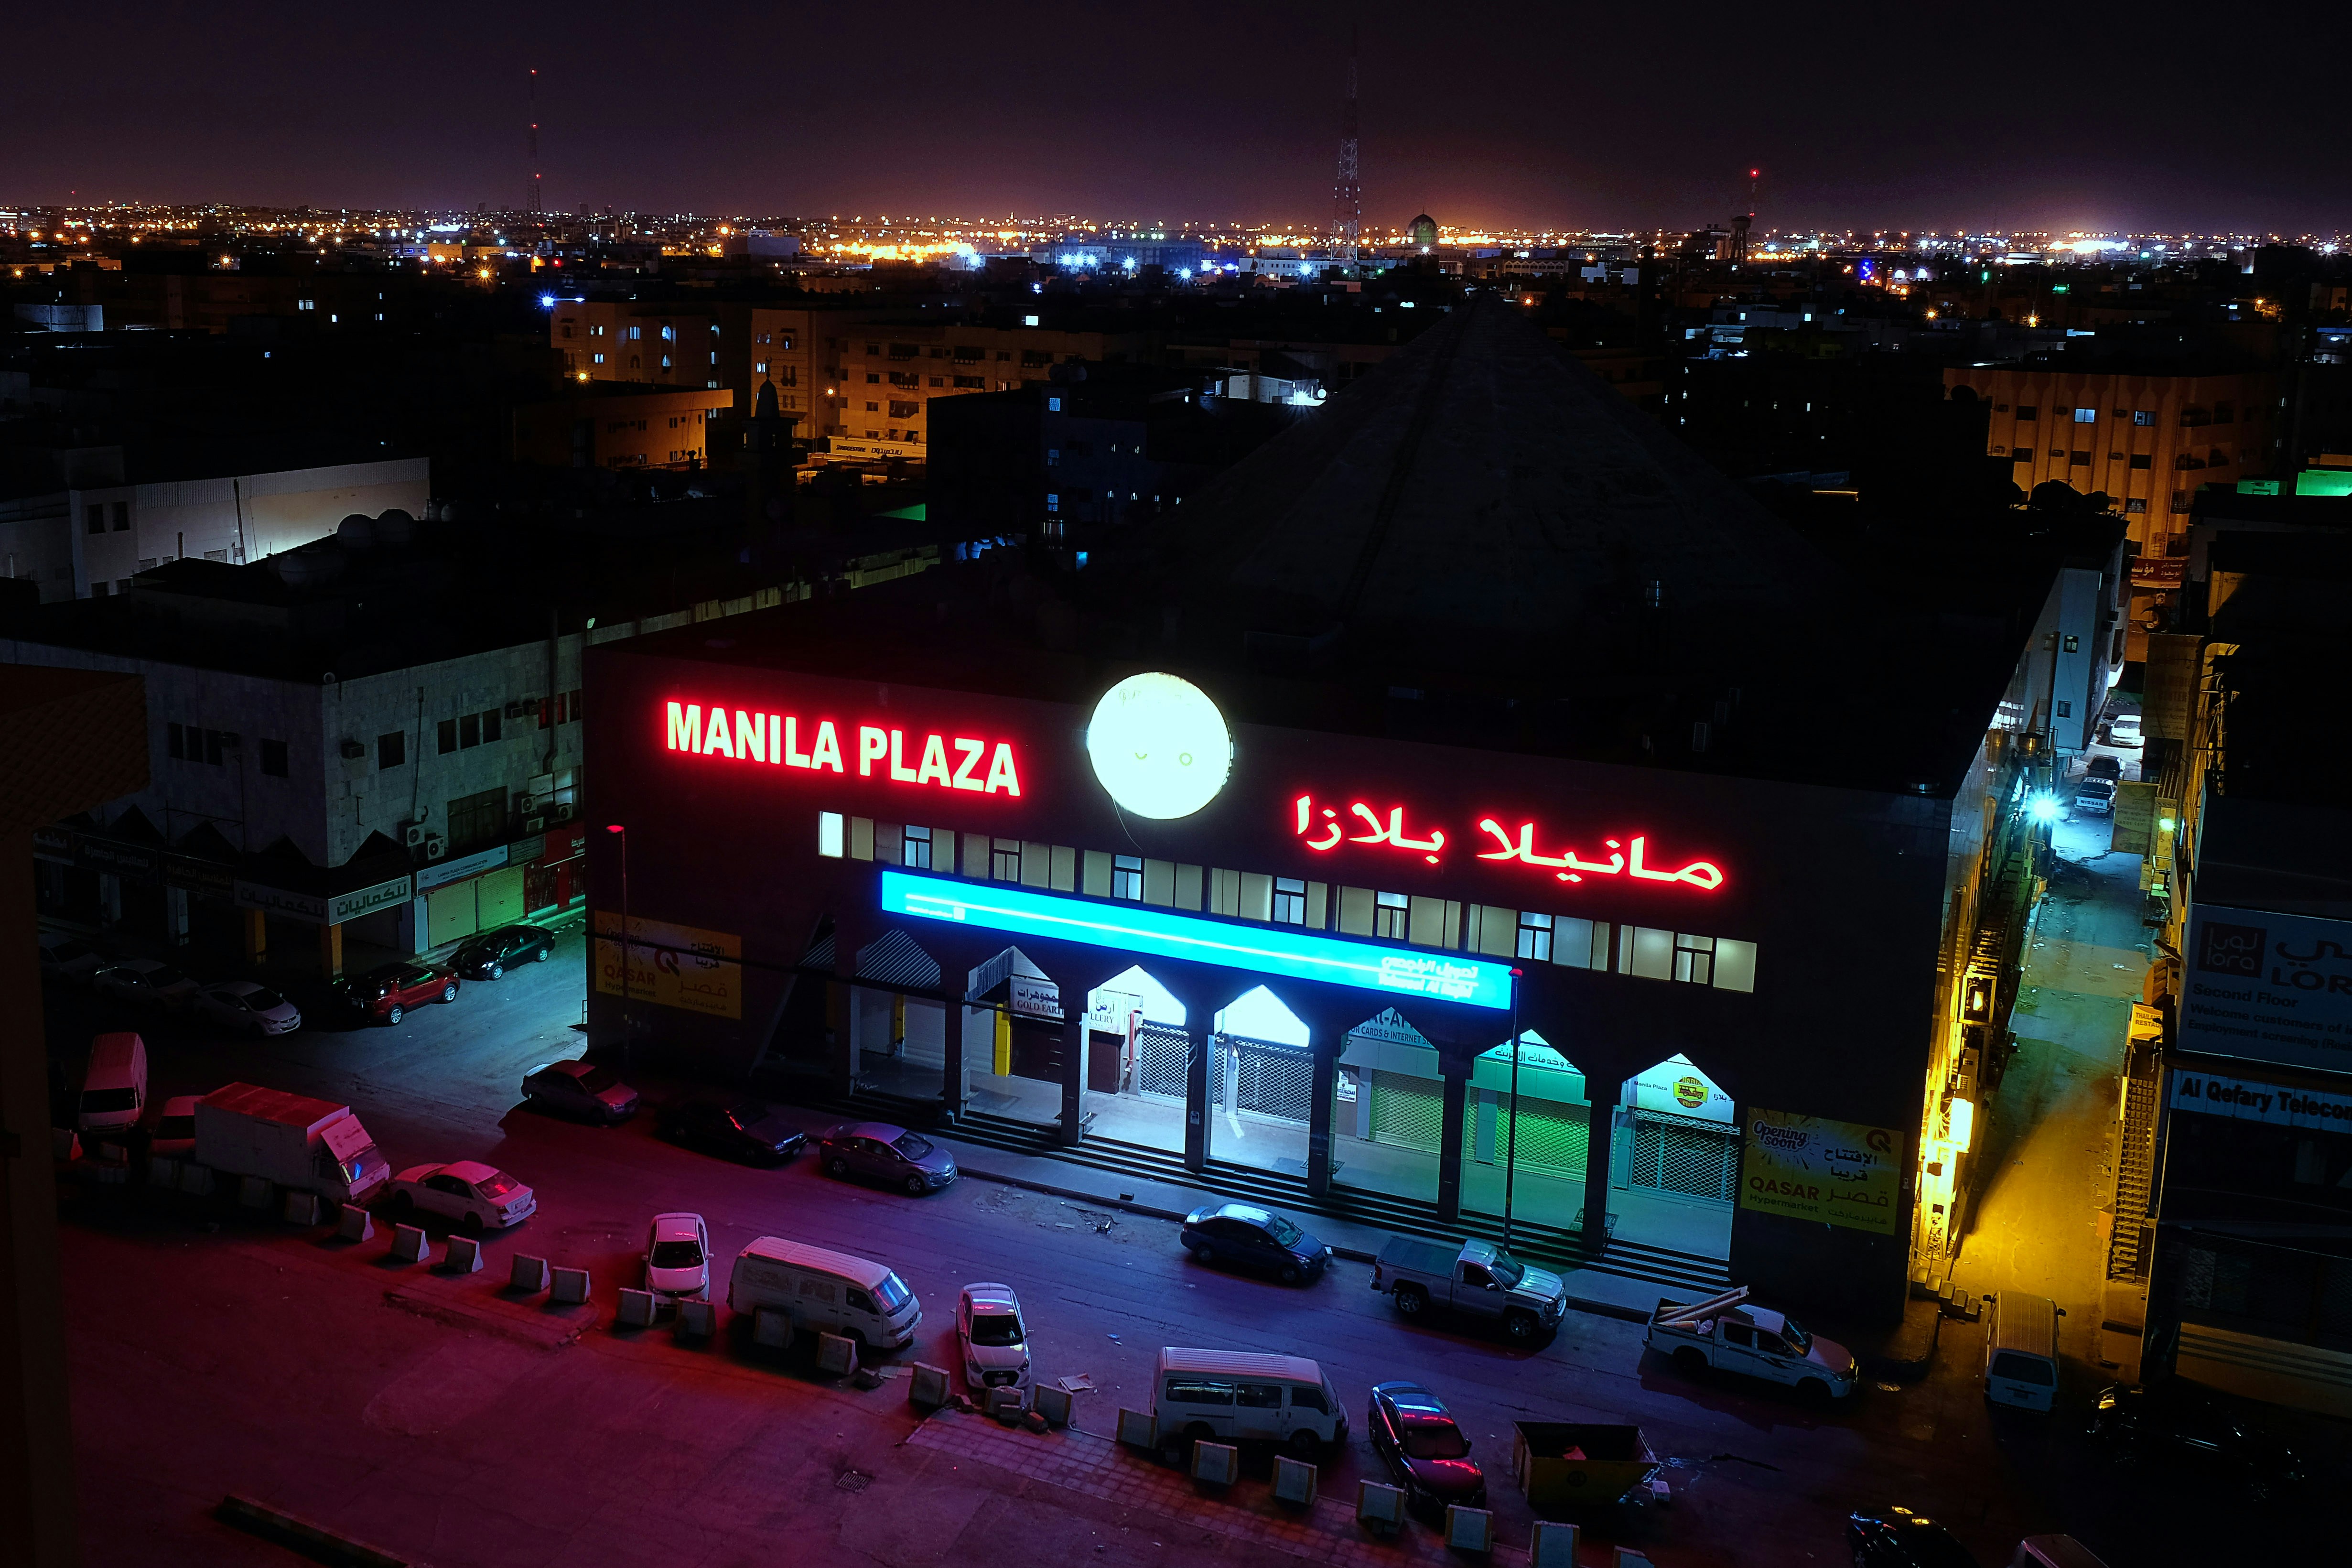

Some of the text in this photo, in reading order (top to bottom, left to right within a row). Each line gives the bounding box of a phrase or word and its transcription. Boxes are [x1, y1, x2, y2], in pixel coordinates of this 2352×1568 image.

[667, 701, 1021, 796] MANILA PLAZA
[1296, 794, 1446, 864] بلازا
[240, 887, 325, 918] للكماليات
[337, 883, 407, 916] للكماليات
[2206, 947, 2255, 971] lora
[604, 964, 656, 986] QASAR
[679, 981, 727, 997] قصر
[2192, 983, 2299, 1008] Second Floor
[1017, 1000, 1040, 1011] GOLD
[2190, 1003, 2250, 1021] Welcome
[2253, 1012, 2323, 1031] customers
[2327, 1022, 2342, 1034] of
[1361, 1026, 1382, 1037] CARDS
[1384, 1030, 1389, 1038] &
[1390, 1031, 1421, 1044] INTERNET
[2188, 1019, 2258, 1039] Employment
[2261, 1030, 2319, 1049] screening
[2180, 1077, 2201, 1098] Al
[2206, 1081, 2273, 1114] Qefary
[1754, 1121, 1807, 1147] Opening
[1764, 1136, 1797, 1149] soon
[1830, 1166, 1868, 1182] قريبا
[1749, 1176, 1820, 1201] QASAR
[1826, 1188, 1888, 1207] قصر
[1749, 1194, 1819, 1212] Hypermarket
